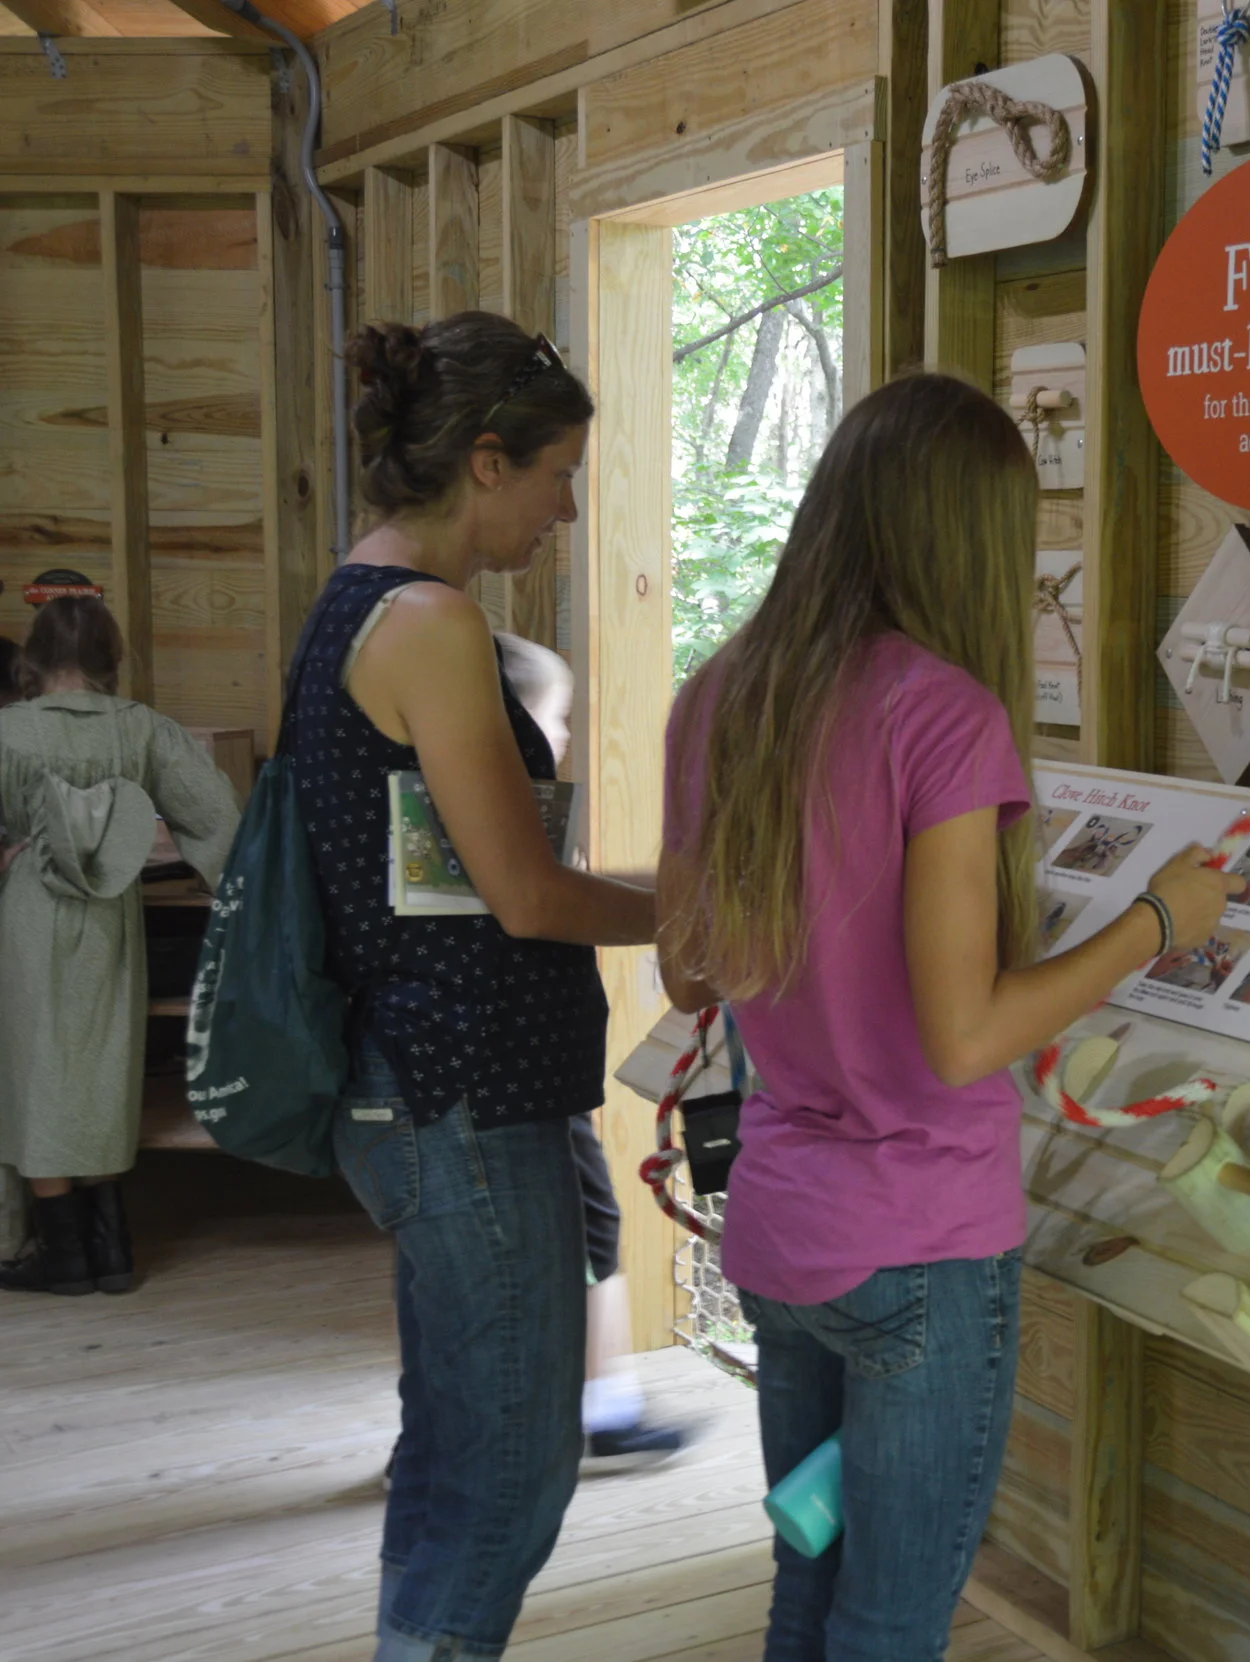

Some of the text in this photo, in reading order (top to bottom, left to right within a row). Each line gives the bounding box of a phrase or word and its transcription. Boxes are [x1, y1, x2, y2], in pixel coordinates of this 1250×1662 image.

[965, 161, 1000, 186] Eye Splice
[1203, 394, 1227, 419] for
[1051, 784, 1152, 812] Clove Hitch Knot
